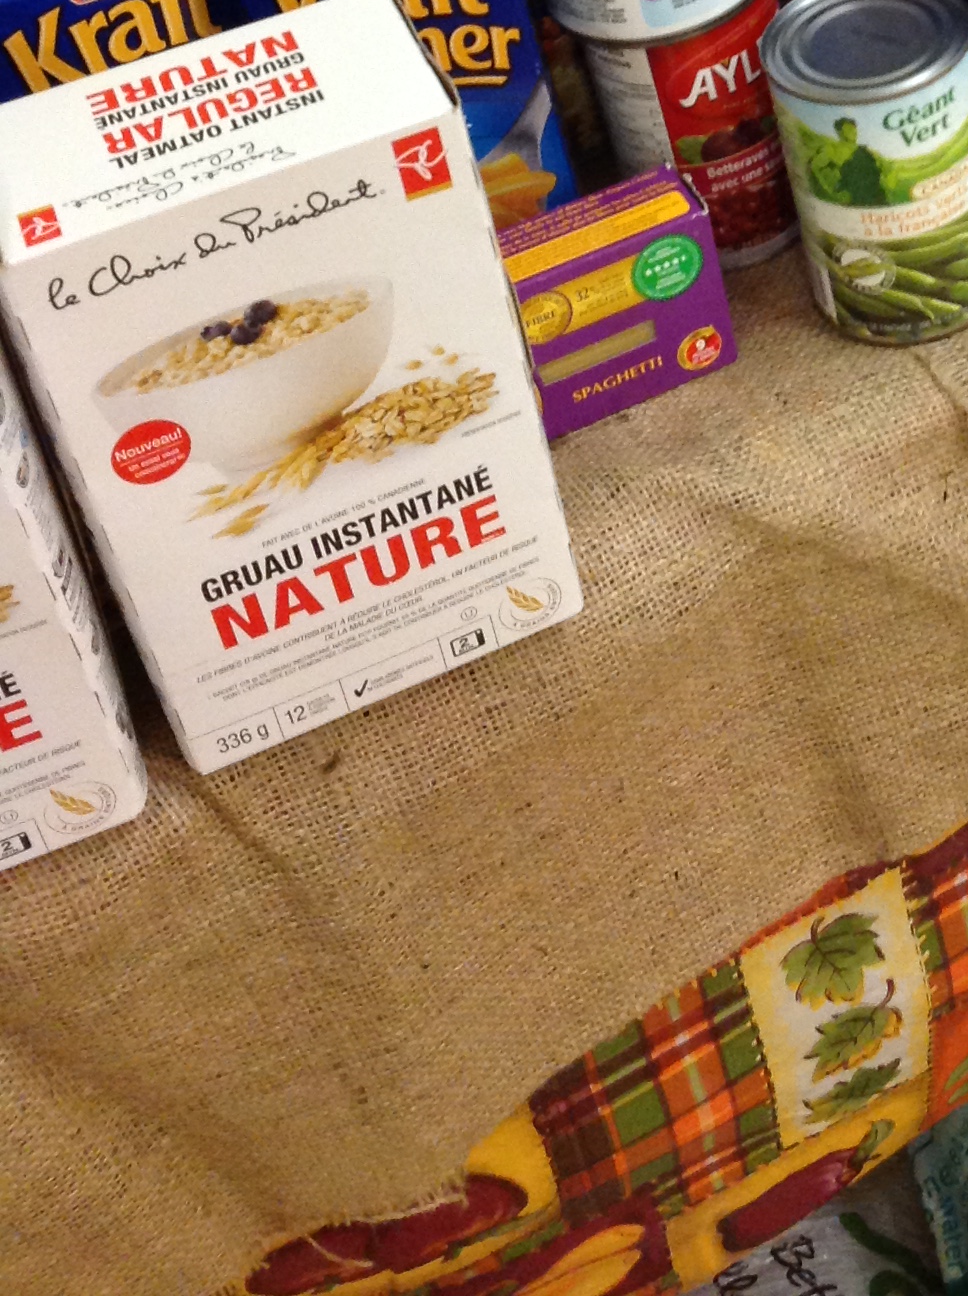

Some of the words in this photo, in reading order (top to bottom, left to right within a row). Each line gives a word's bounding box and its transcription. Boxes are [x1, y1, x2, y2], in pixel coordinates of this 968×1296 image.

[85, 30, 299, 117] NATURE
[235, 51, 305, 85] GRUAU
[679, 48, 761, 108] AYL
[94, 78, 228, 131] INSTANTANÉ
[102, 66, 319, 155] REGULAR
[230, 89, 325, 132] INSTANT
[882, 87, 955, 130] Géant
[108, 124, 223, 170] OATMEAL
[899, 113, 950, 146] Vert
[712, 178, 739, 192] avec
[88, 254, 187, 297] Choix
[572, 355, 664, 403] SPAGHETTI
[114, 427, 183, 463] Nouveau!
[200, 543, 304, 602] GRUAU
[309, 464, 493, 560] INSTANTANÉ
[209, 494, 508, 651] NATURE
[284, 705, 307, 725] 12
[216, 728, 252, 754] 336
[257, 722, 270, 741] g
